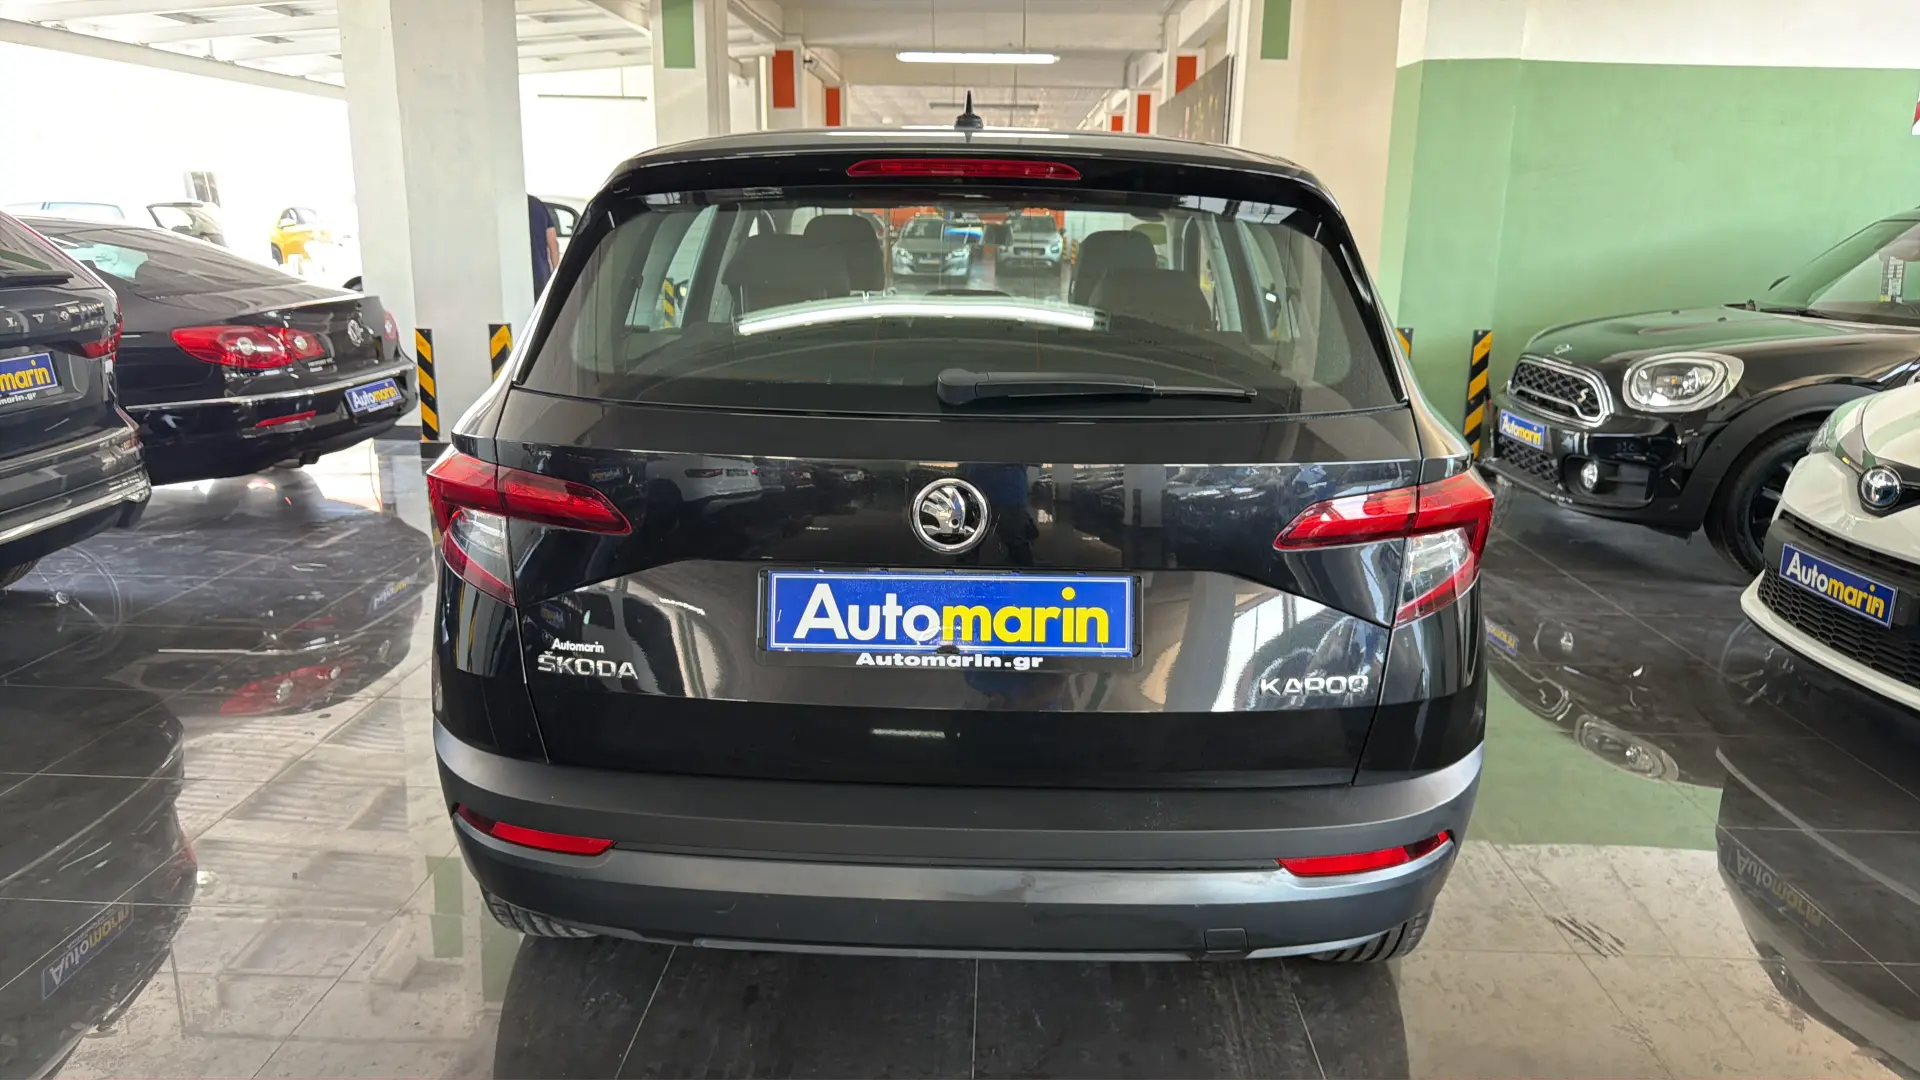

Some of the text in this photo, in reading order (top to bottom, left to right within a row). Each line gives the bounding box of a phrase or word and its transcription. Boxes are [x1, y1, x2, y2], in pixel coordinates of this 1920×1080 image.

[1786, 551, 1885, 618] Automarin
[793, 583, 1108, 643] Automarin
[552, 638, 605, 653] Automarin
[538, 651, 638, 680] ŠKODA
[856, 652, 1043, 671] Automarin.gr
[1259, 675, 1369, 696] KAROQ
